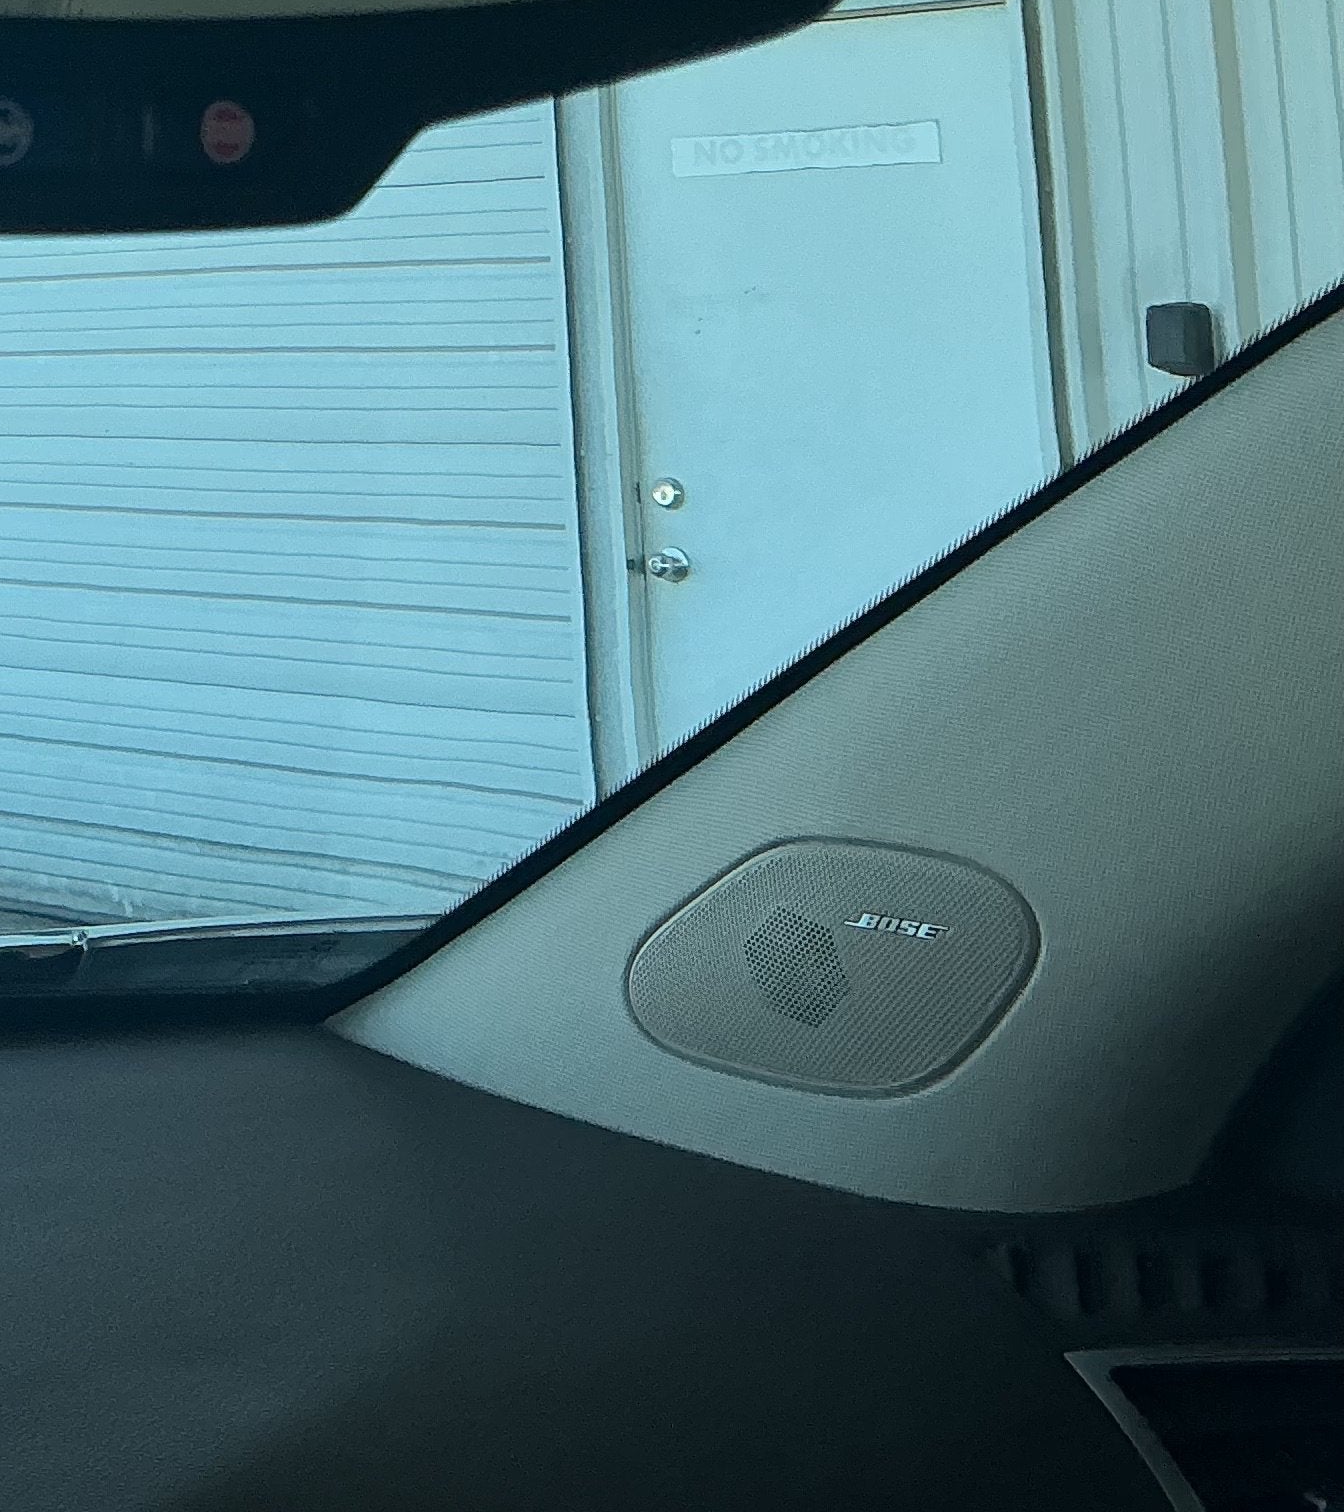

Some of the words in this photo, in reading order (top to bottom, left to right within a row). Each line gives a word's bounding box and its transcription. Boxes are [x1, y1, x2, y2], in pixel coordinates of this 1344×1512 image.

[693, 138, 745, 167] NO
[754, 127, 917, 162] SMOKING
[844, 912, 950, 940] BOSE
